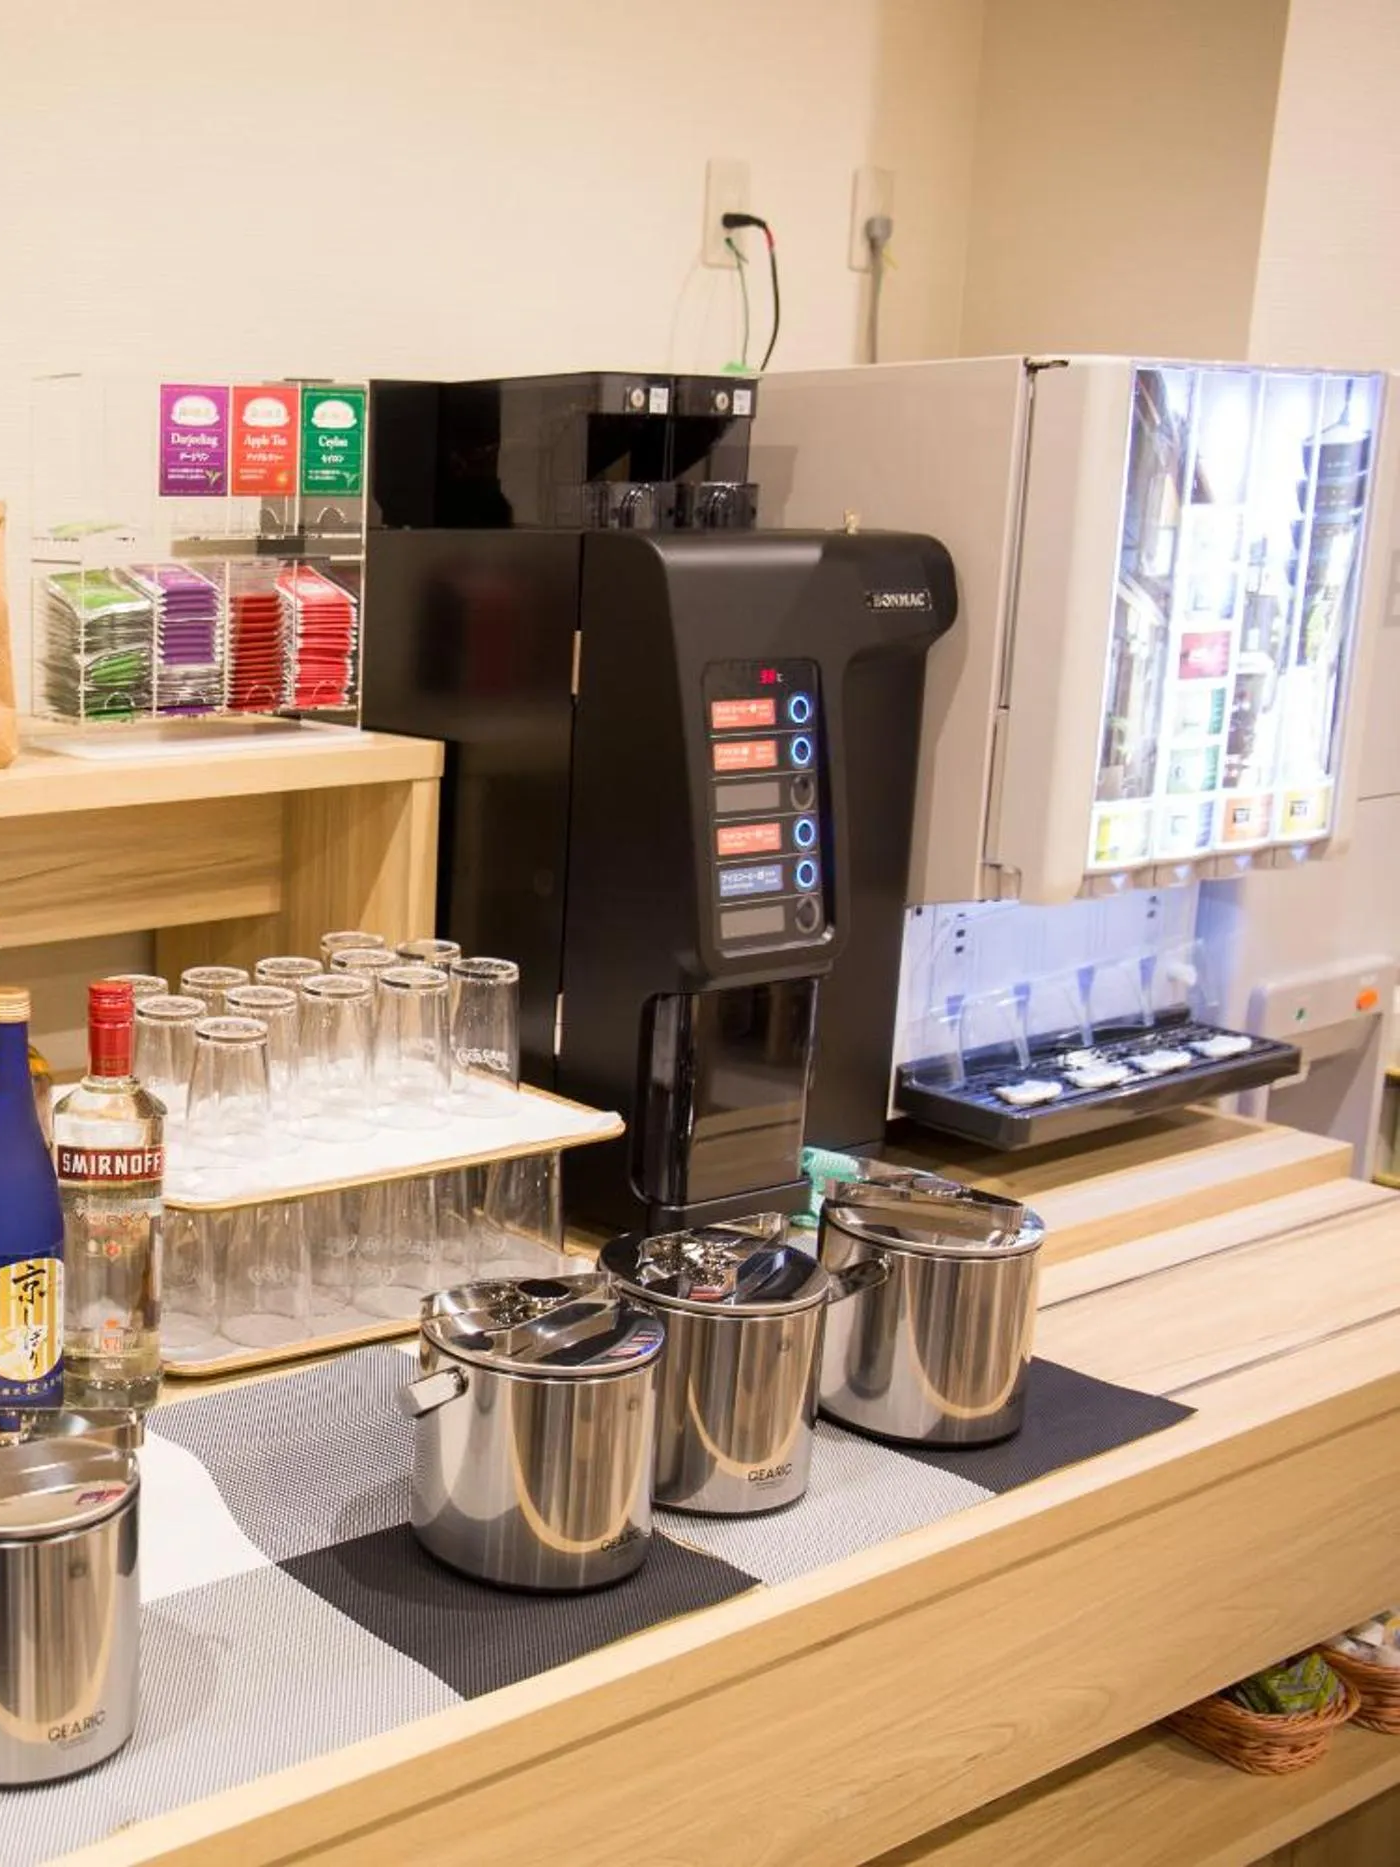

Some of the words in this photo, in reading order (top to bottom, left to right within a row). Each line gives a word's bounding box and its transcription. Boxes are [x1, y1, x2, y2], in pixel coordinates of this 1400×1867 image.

[171, 432, 218, 448] Darjeeling
[243, 434, 270, 449] Apple
[271, 433, 288, 446] Tea
[318, 435, 348, 450] Ceylon
[63, 1153, 161, 1175] SMIRNOFF
